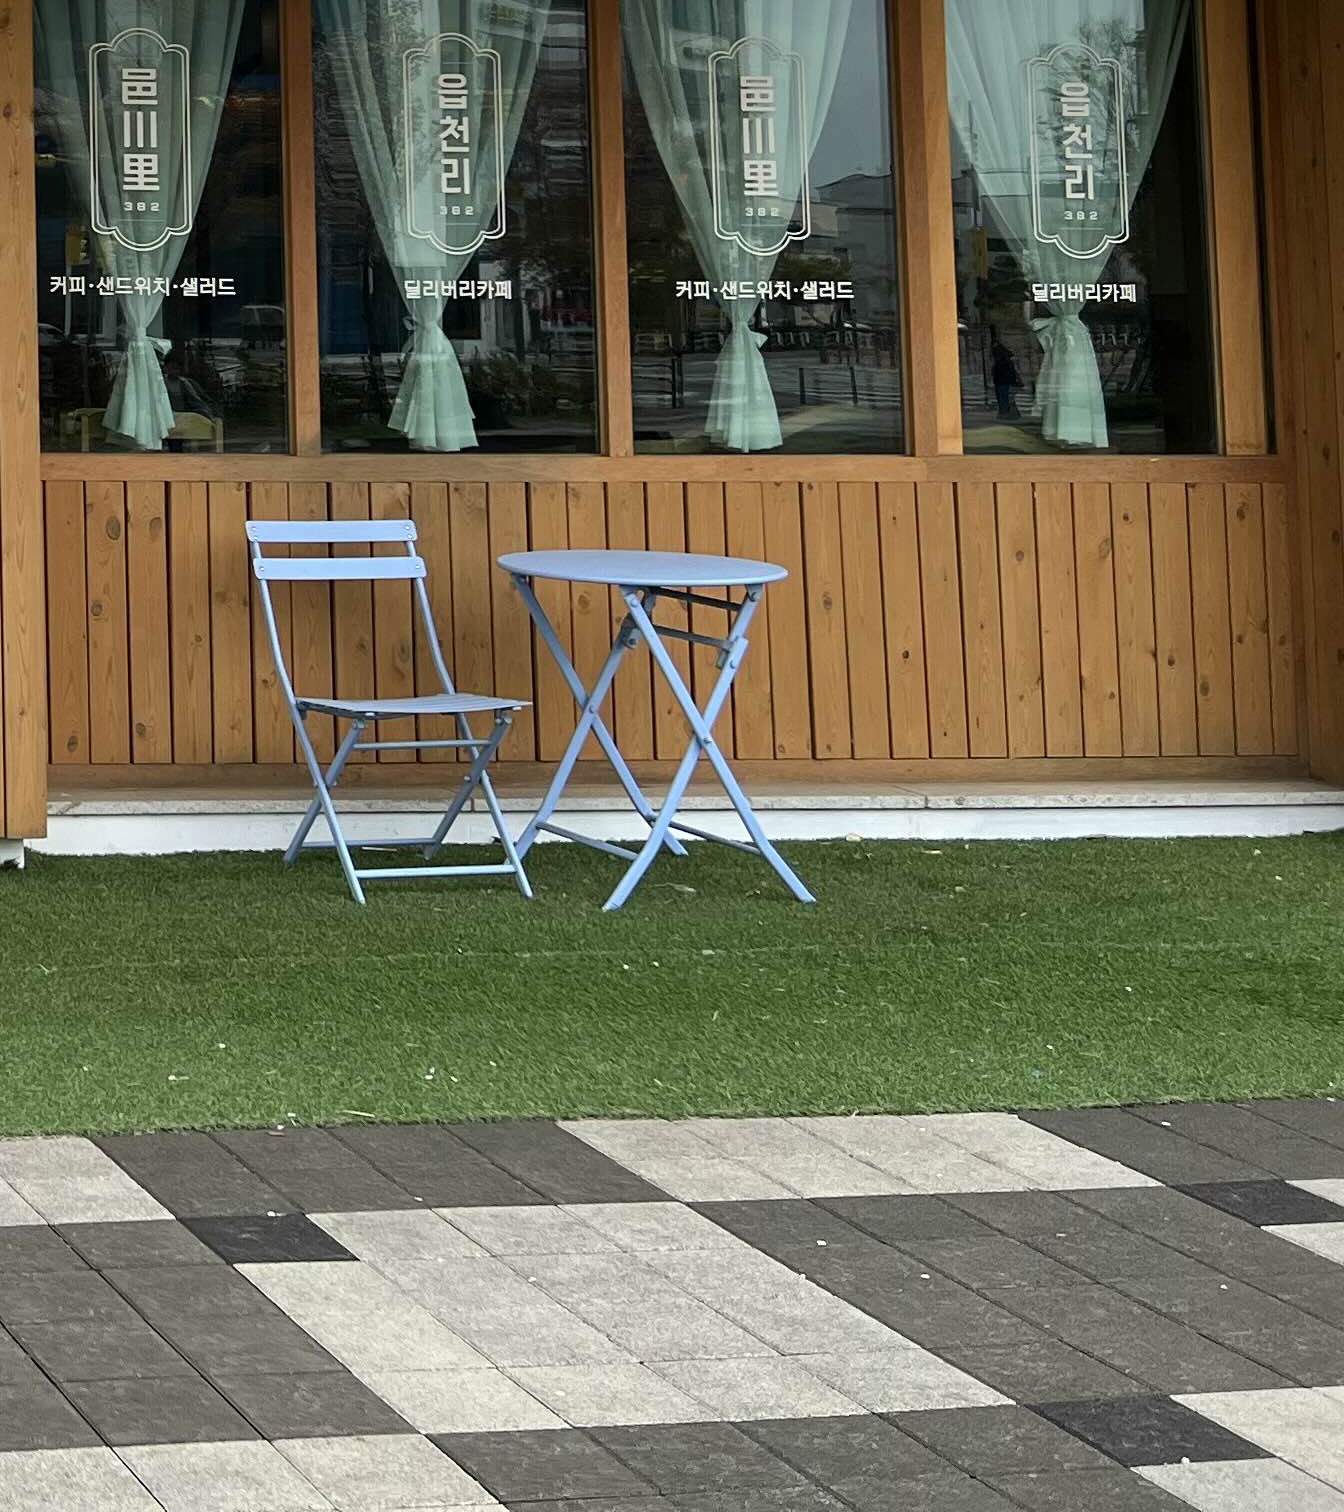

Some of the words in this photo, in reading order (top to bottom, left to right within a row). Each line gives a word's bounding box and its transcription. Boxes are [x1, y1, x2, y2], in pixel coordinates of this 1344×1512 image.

[121, 68, 161, 192] 邑川里
[437, 72, 472, 196] 읍천리
[739, 75, 779, 198] 邑川里
[1059, 81, 1095, 201] 읍천리
[123, 201, 161, 213] 382
[439, 205, 475, 217] 382
[1063, 210, 1099, 221] 382
[404, 279, 513, 301] 딜리버리카페
[1031, 283, 1137, 304] 딜리버리카페
